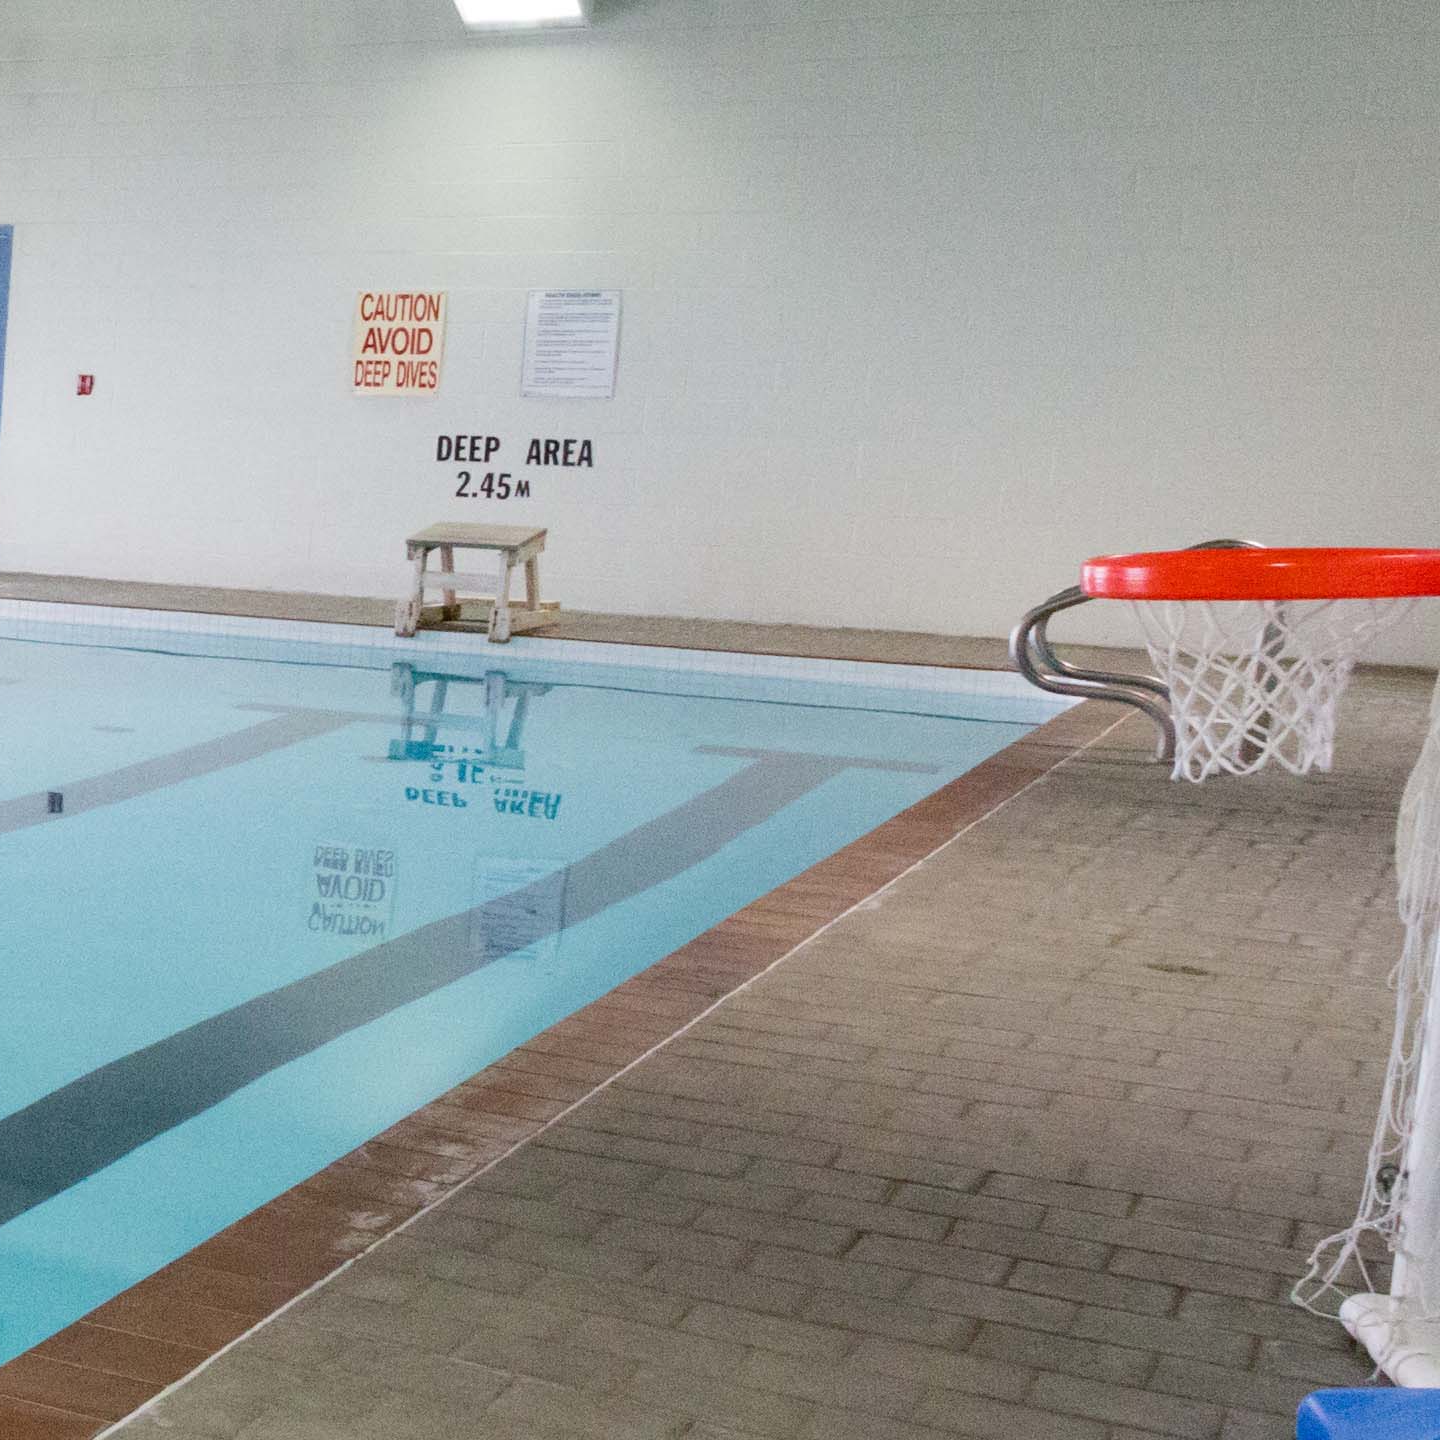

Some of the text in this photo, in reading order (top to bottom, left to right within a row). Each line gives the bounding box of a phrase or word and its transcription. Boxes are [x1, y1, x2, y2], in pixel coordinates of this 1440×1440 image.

[360, 293, 441, 322] CAUTION
[361, 327, 433, 356] AVOID
[354, 360, 438, 390] DEEP DIVES
[436, 435, 594, 468] DEEP AREA
